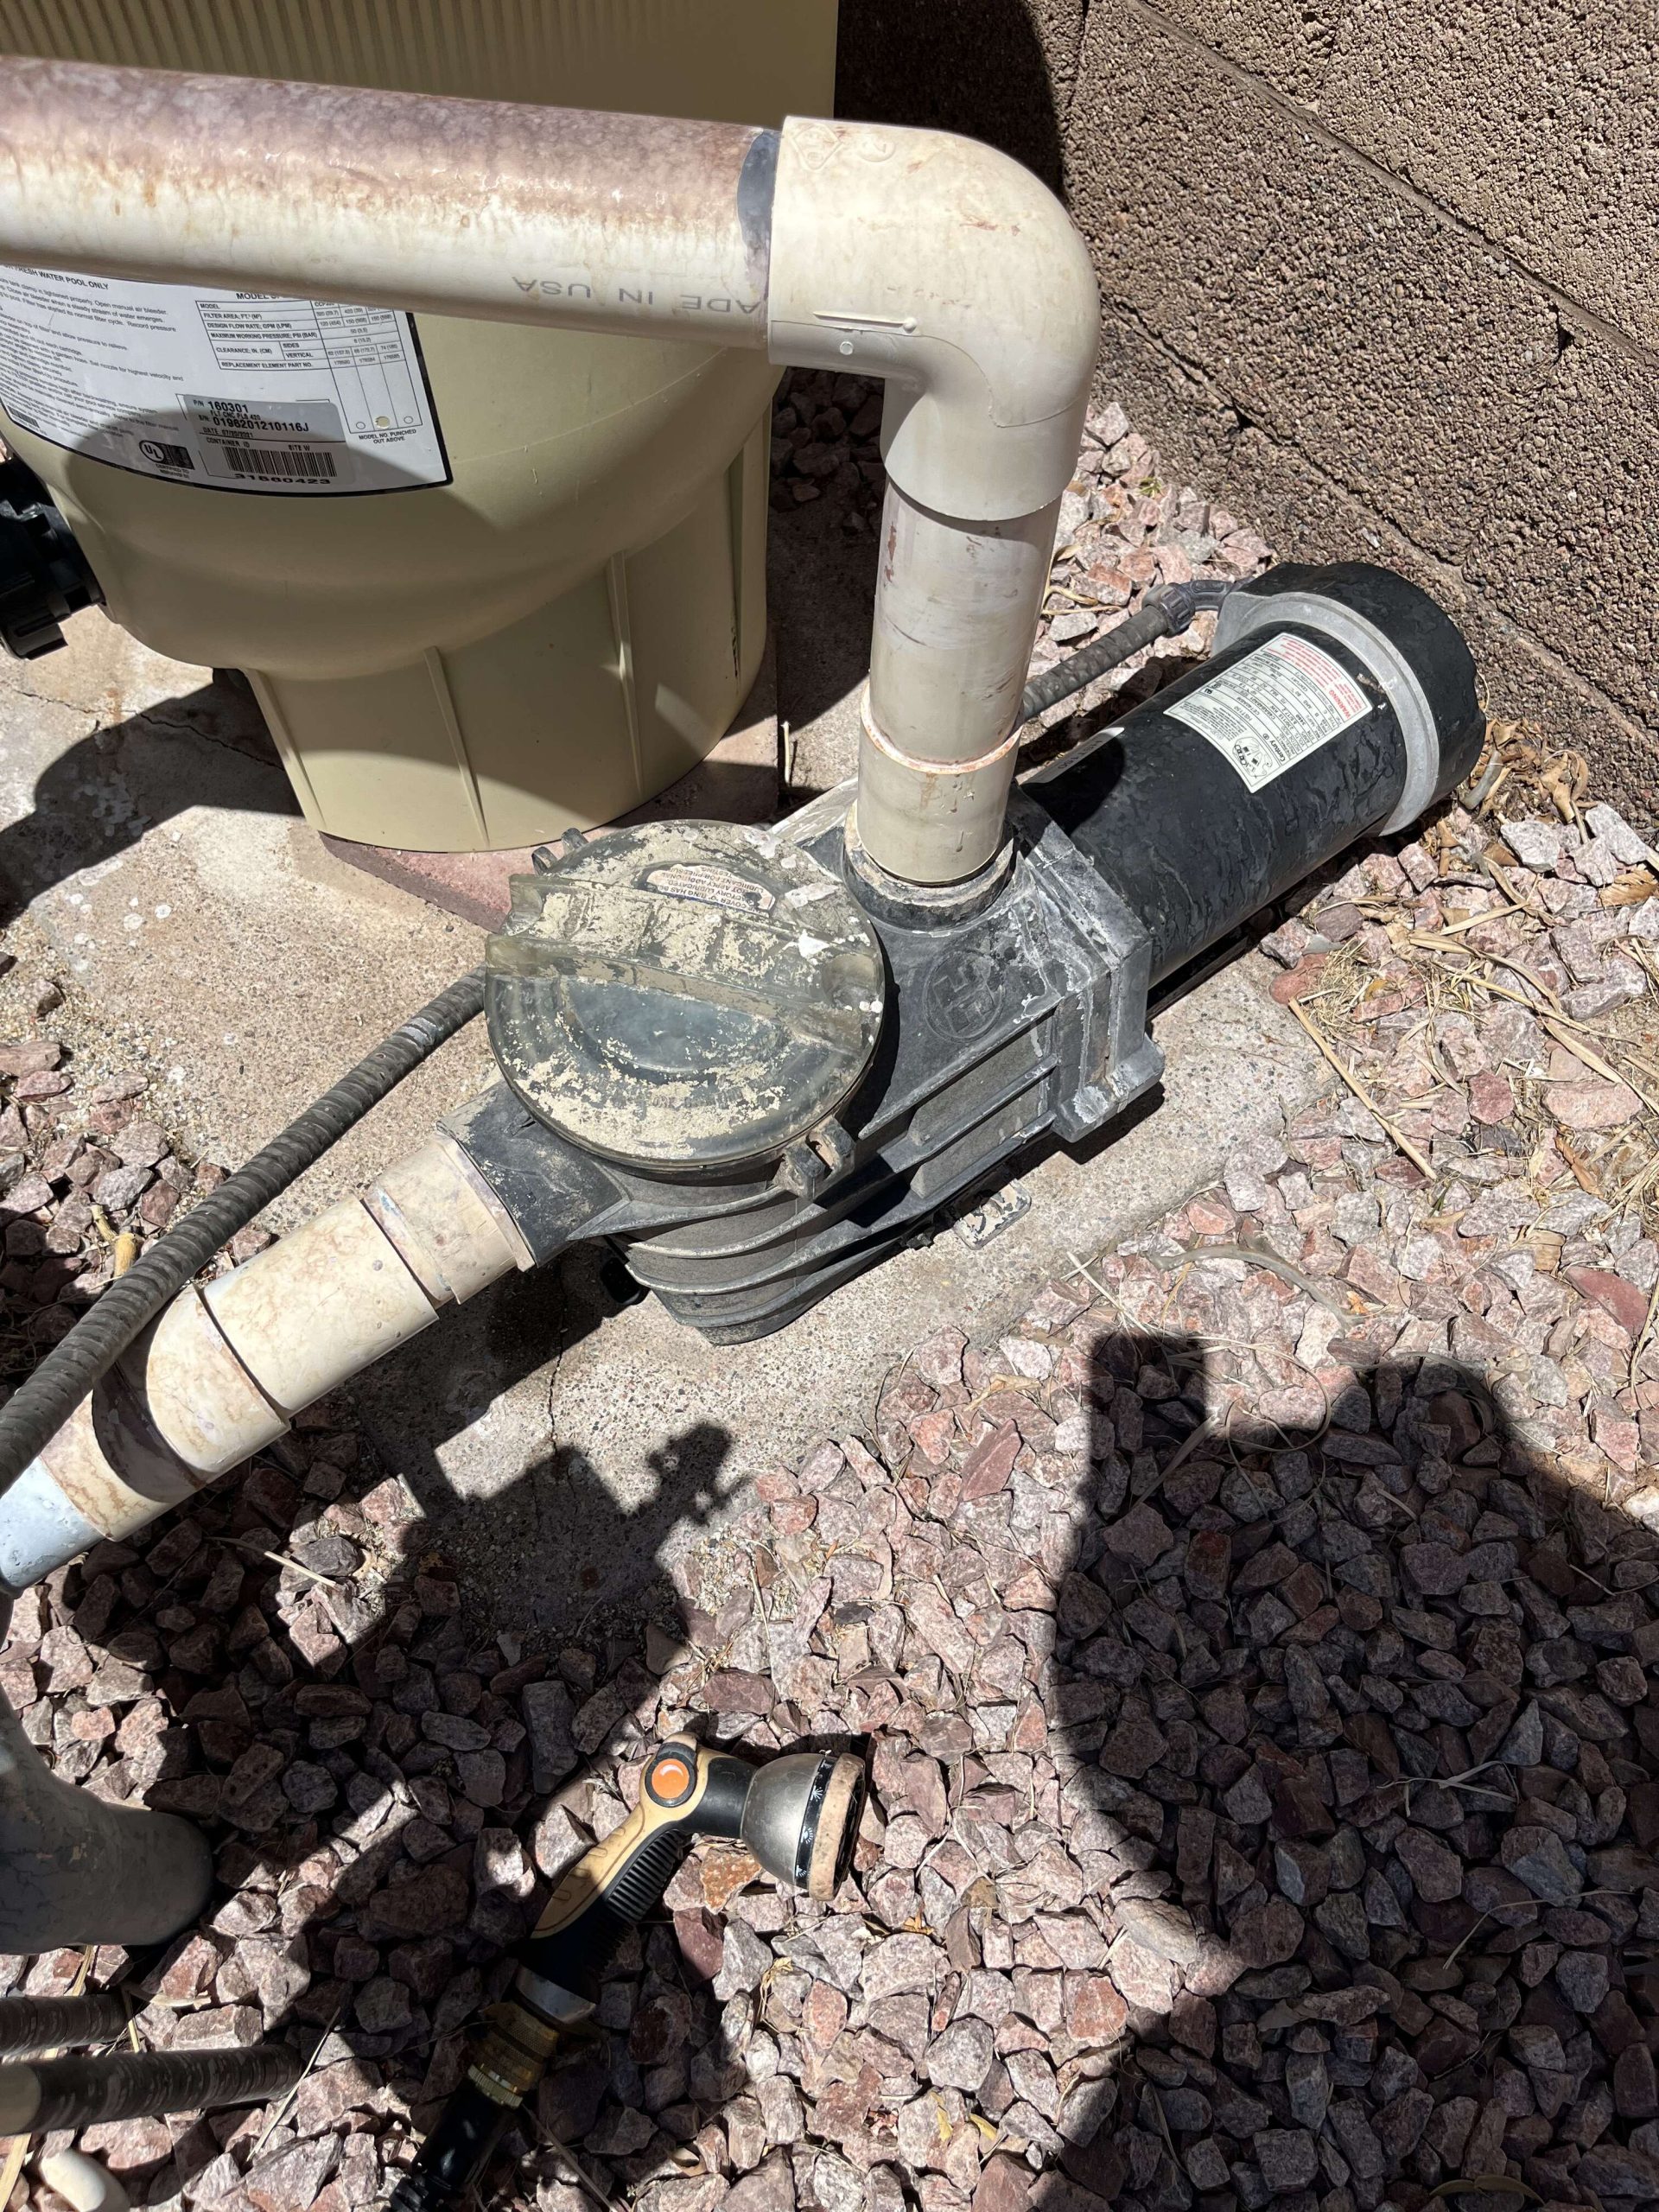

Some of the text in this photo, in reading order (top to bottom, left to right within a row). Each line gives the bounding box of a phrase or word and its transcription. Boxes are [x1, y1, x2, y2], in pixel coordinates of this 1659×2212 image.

[39, 270, 66, 283] WATER
[66, 276, 87, 288] POOL
[88, 281, 110, 290] ONLY
[511, 276, 760, 315] ADE IN USA
[208, 401, 249, 413] 160301
[213, 416, 309, 432] 0196201210116J
[207, 437, 241, 447] CONTAINER
[1326, 689, 1352, 718] WARNING
[1268, 739, 1286, 762] Century
[662, 872, 707, 885] ADDITIONAL
[705, 874, 721, 883] FOR
[670, 887, 688, 895] HAS
[707, 881, 731, 892] APPLY
[721, 879, 764, 893] LUBRICANT
[715, 890, 747, 901] ACTORY
[720, 899, 747, 909] COVER
